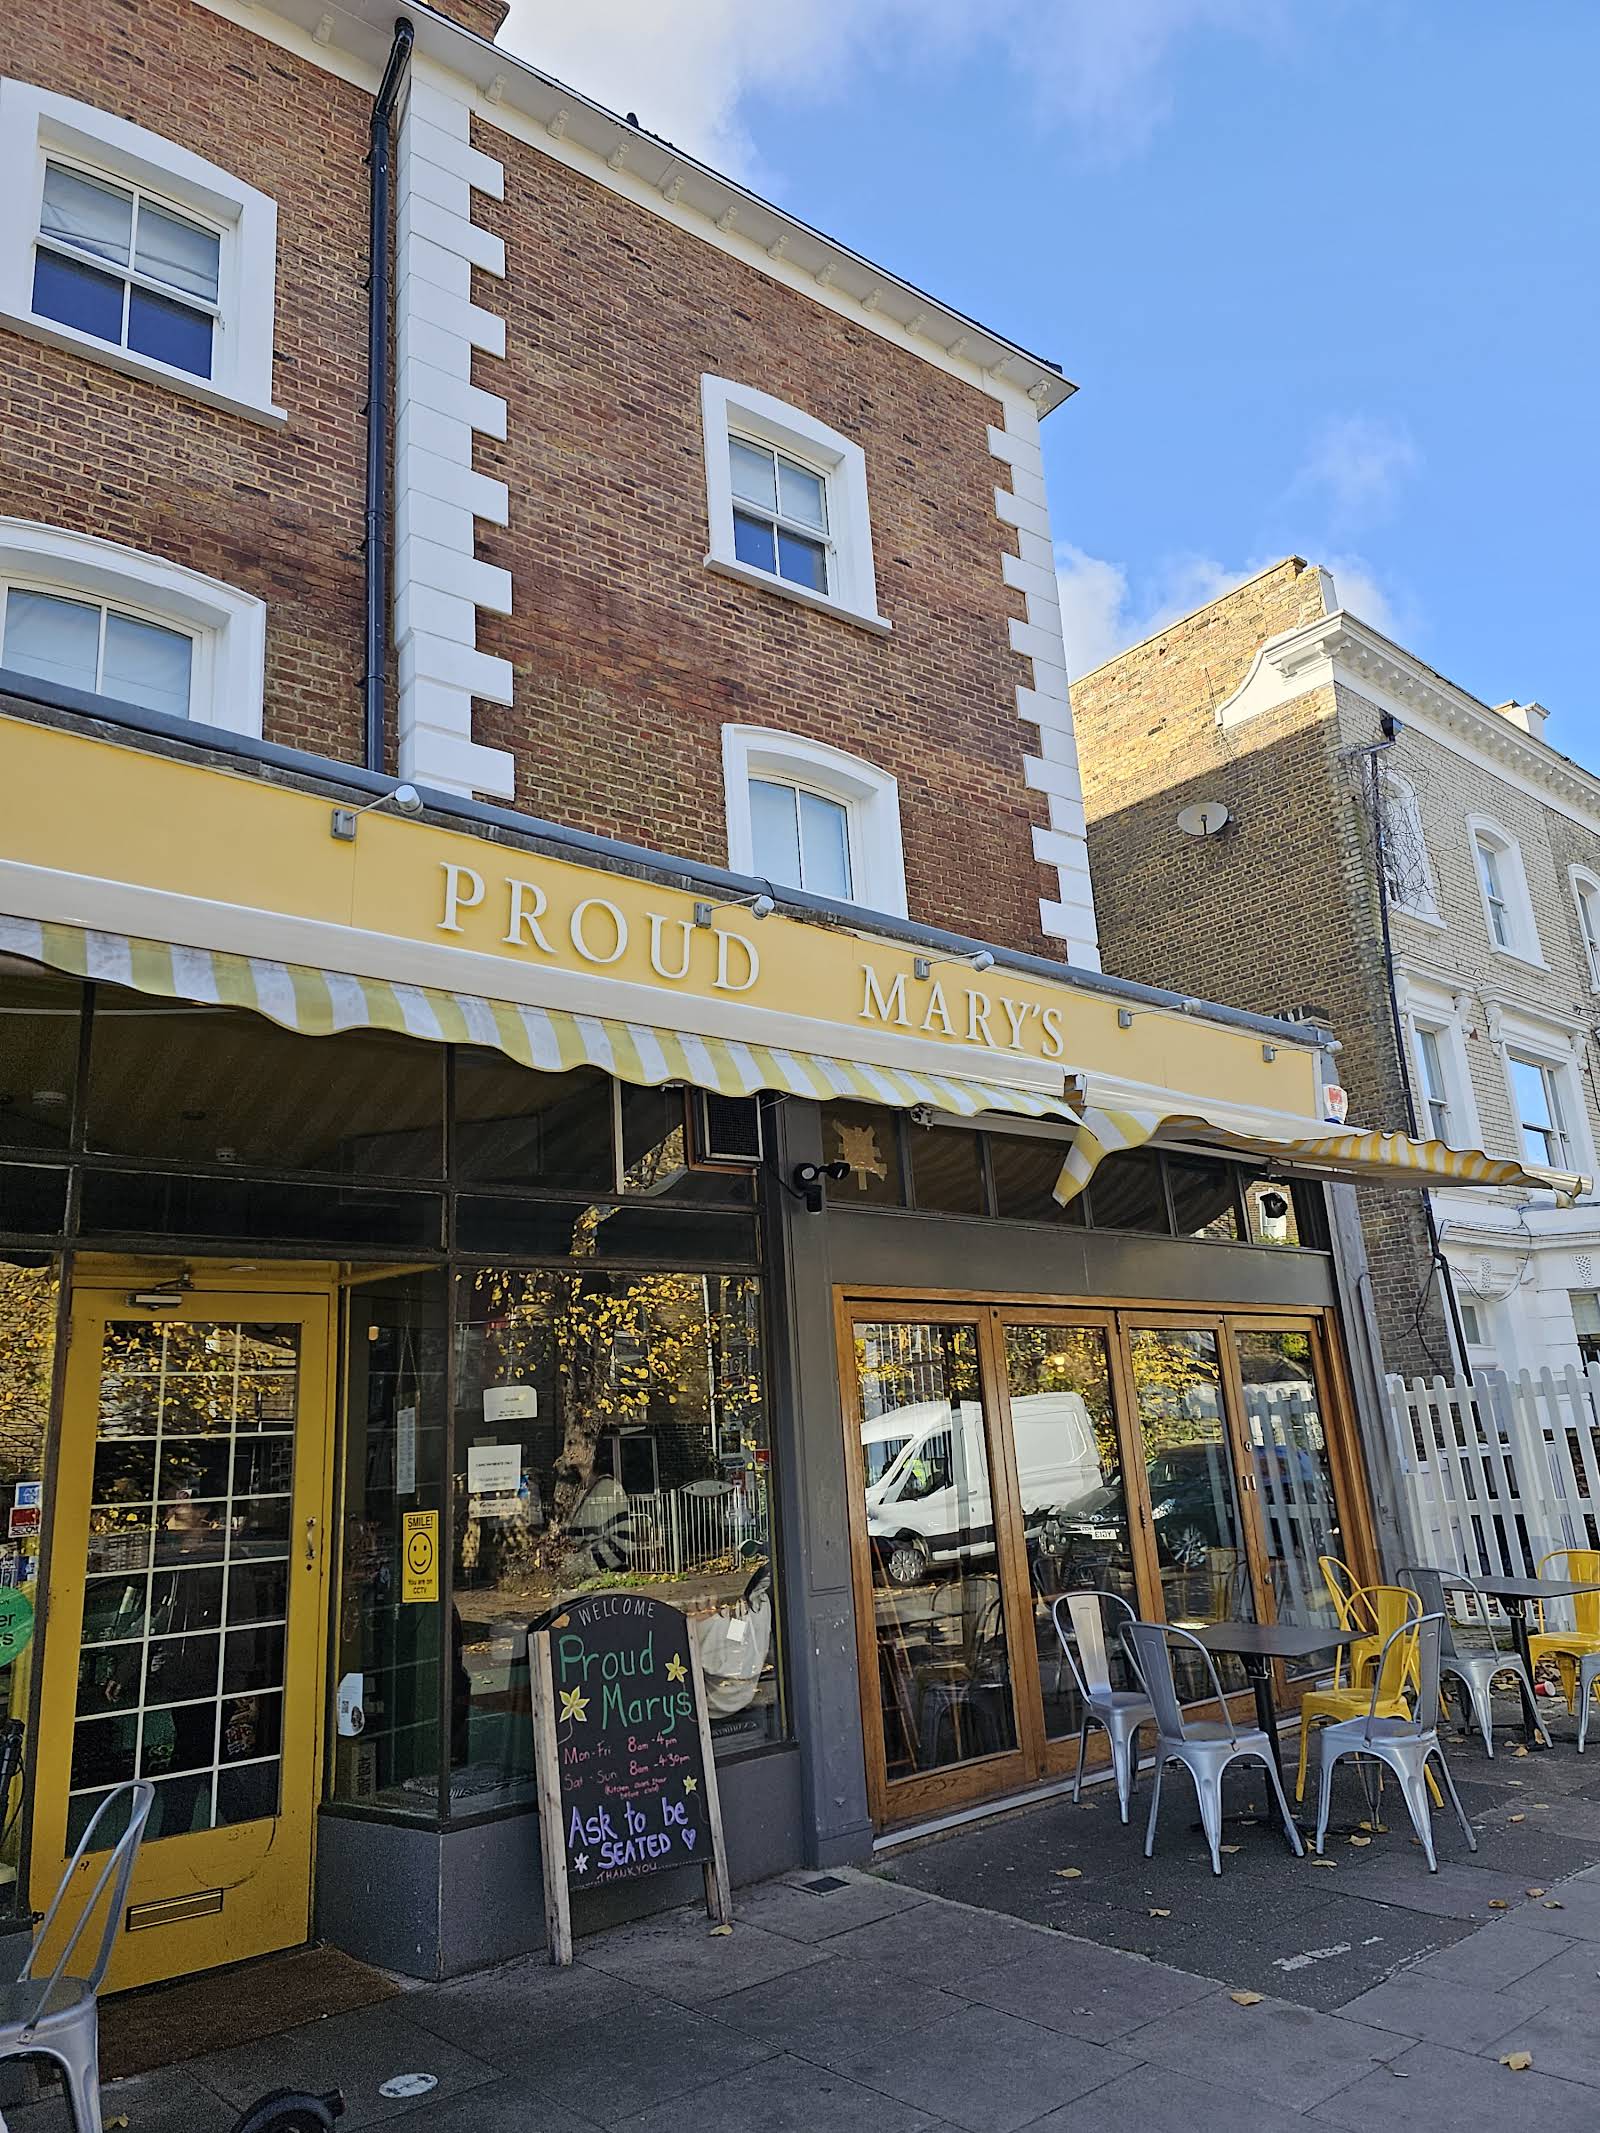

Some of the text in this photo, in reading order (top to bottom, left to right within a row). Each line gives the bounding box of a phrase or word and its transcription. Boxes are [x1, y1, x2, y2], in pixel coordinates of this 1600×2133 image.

[436, 861, 1064, 1058] PROUD MARY'S
[408, 1516, 433, 1527] SMILE!
[578, 1597, 656, 1626] WELCOME
[559, 1630, 654, 1683] Proud
[602, 1683, 692, 1735] Marys
[568, 1797, 688, 1848] Ask to be
[597, 1832, 671, 1869] SEATED
